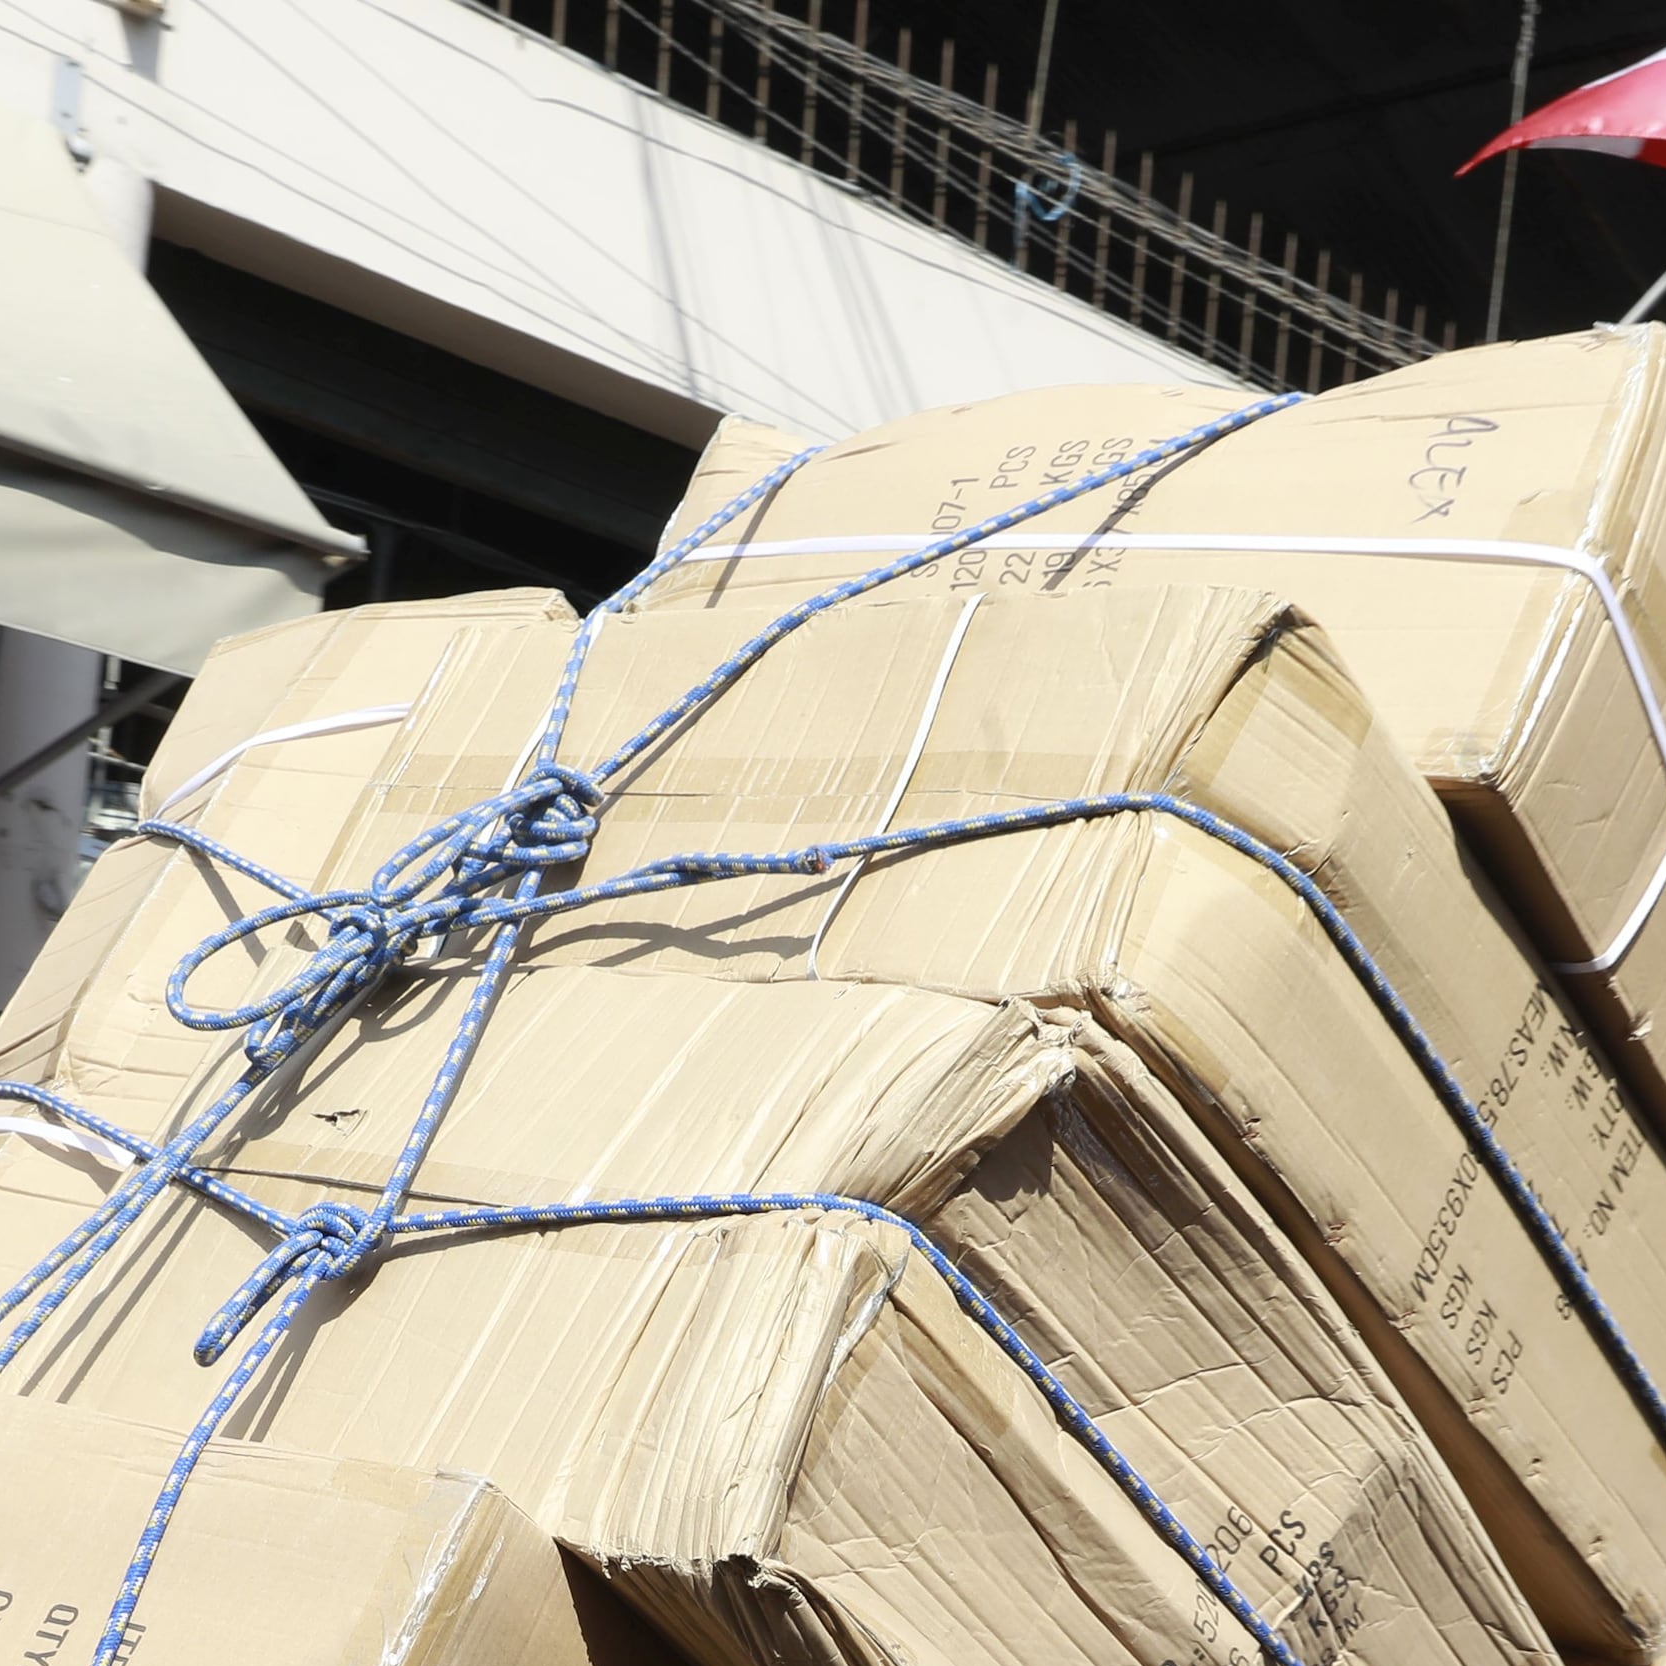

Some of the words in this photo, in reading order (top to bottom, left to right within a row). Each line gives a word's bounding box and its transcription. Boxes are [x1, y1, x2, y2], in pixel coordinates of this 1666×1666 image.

[990, 445, 1037, 492] PCS
[1041, 440, 1089, 487] KGS
[1603, 1126, 1647, 1196] TEM
[1439, 1262, 1473, 1331] KGS
[1465, 1298, 1500, 1368] KGS
[1490, 1329, 1523, 1397] PCS
[1259, 1510, 1307, 1576] PCS
